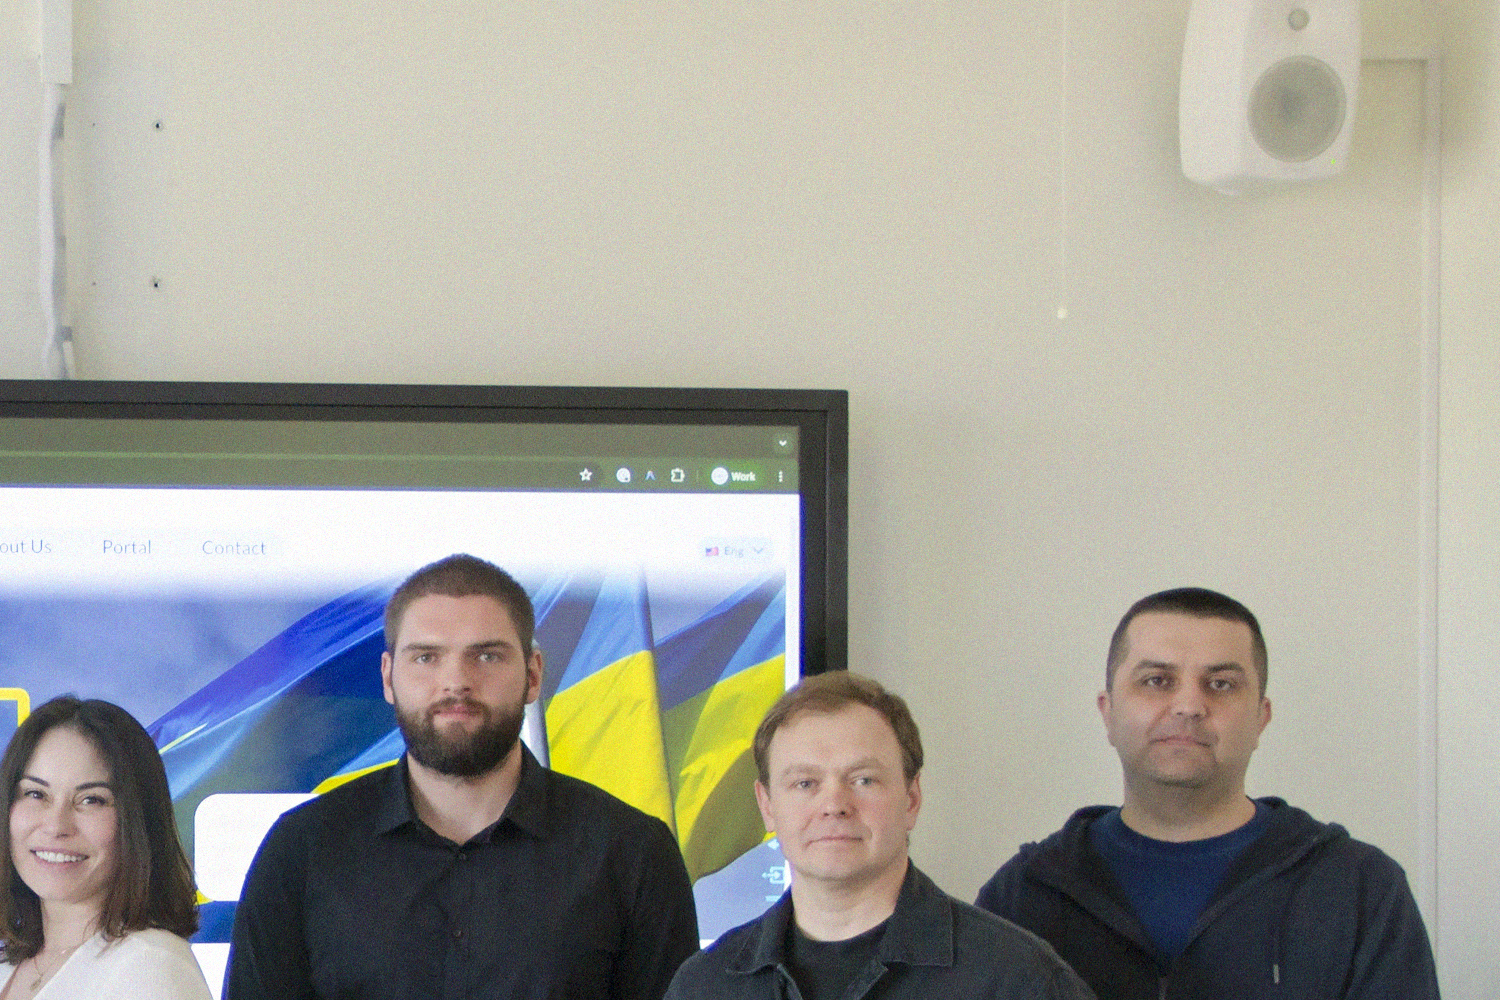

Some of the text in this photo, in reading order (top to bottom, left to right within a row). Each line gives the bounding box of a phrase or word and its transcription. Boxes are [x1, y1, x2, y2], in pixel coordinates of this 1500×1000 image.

[731, 471, 756, 482] Work
[31, 538, 52, 554] Us
[102, 538, 152, 555] Portal
[202, 539, 267, 556] Contact
